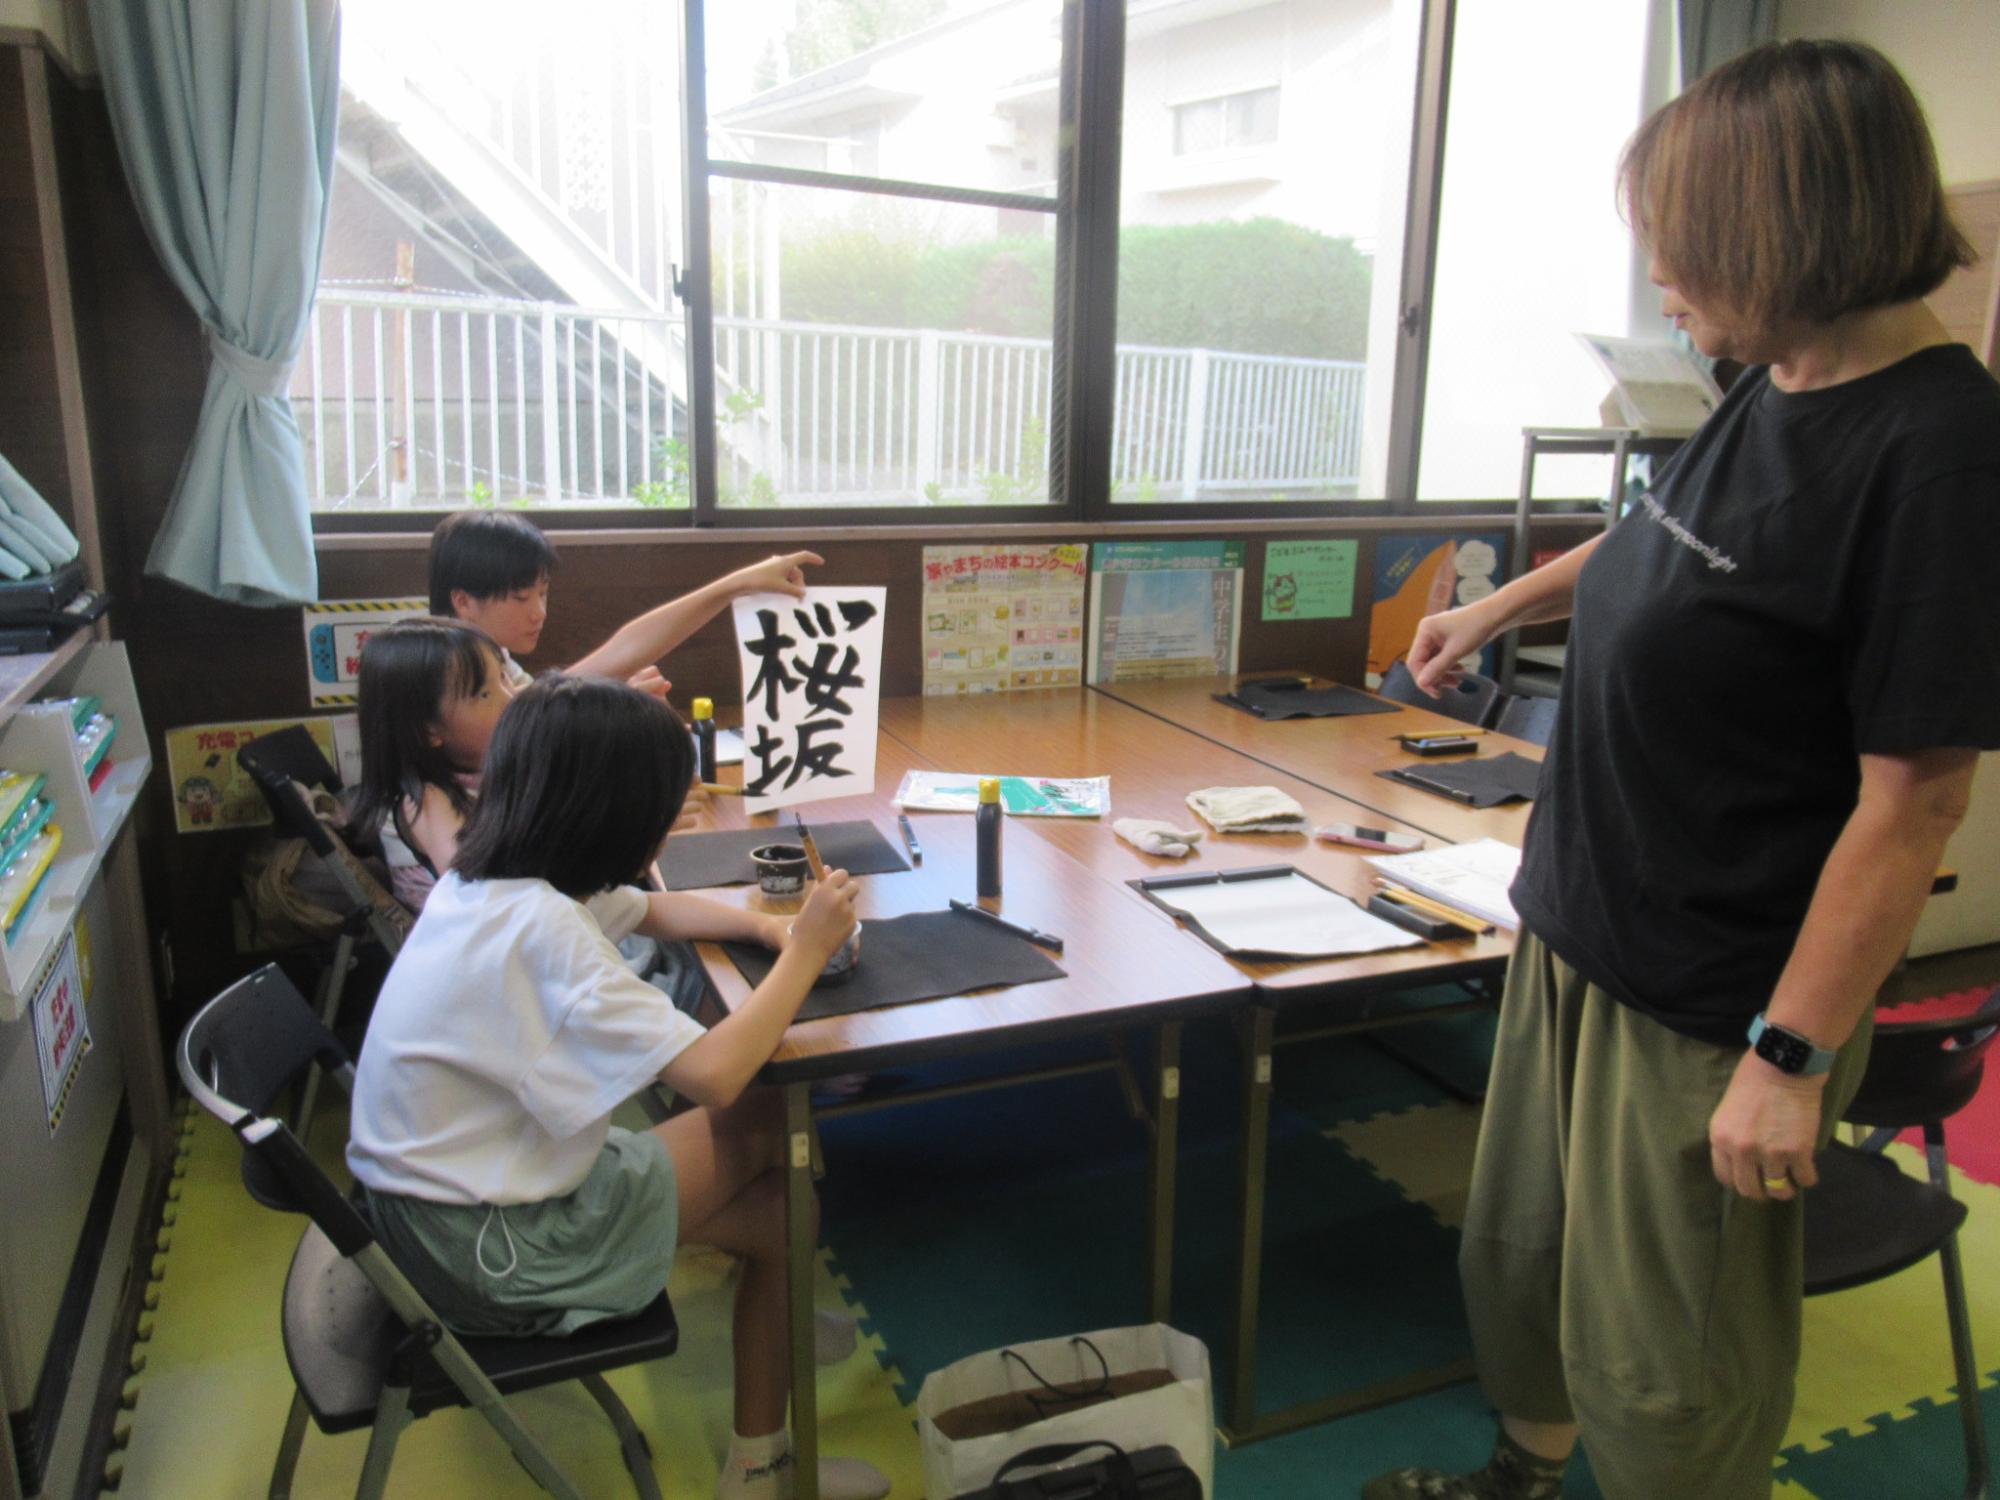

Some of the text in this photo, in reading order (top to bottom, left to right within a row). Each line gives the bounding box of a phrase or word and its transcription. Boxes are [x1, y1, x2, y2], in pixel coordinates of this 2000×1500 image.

[926, 554, 1087, 581] 家やまちの絵本コンクール
[744, 600, 877, 796] 桜坂
